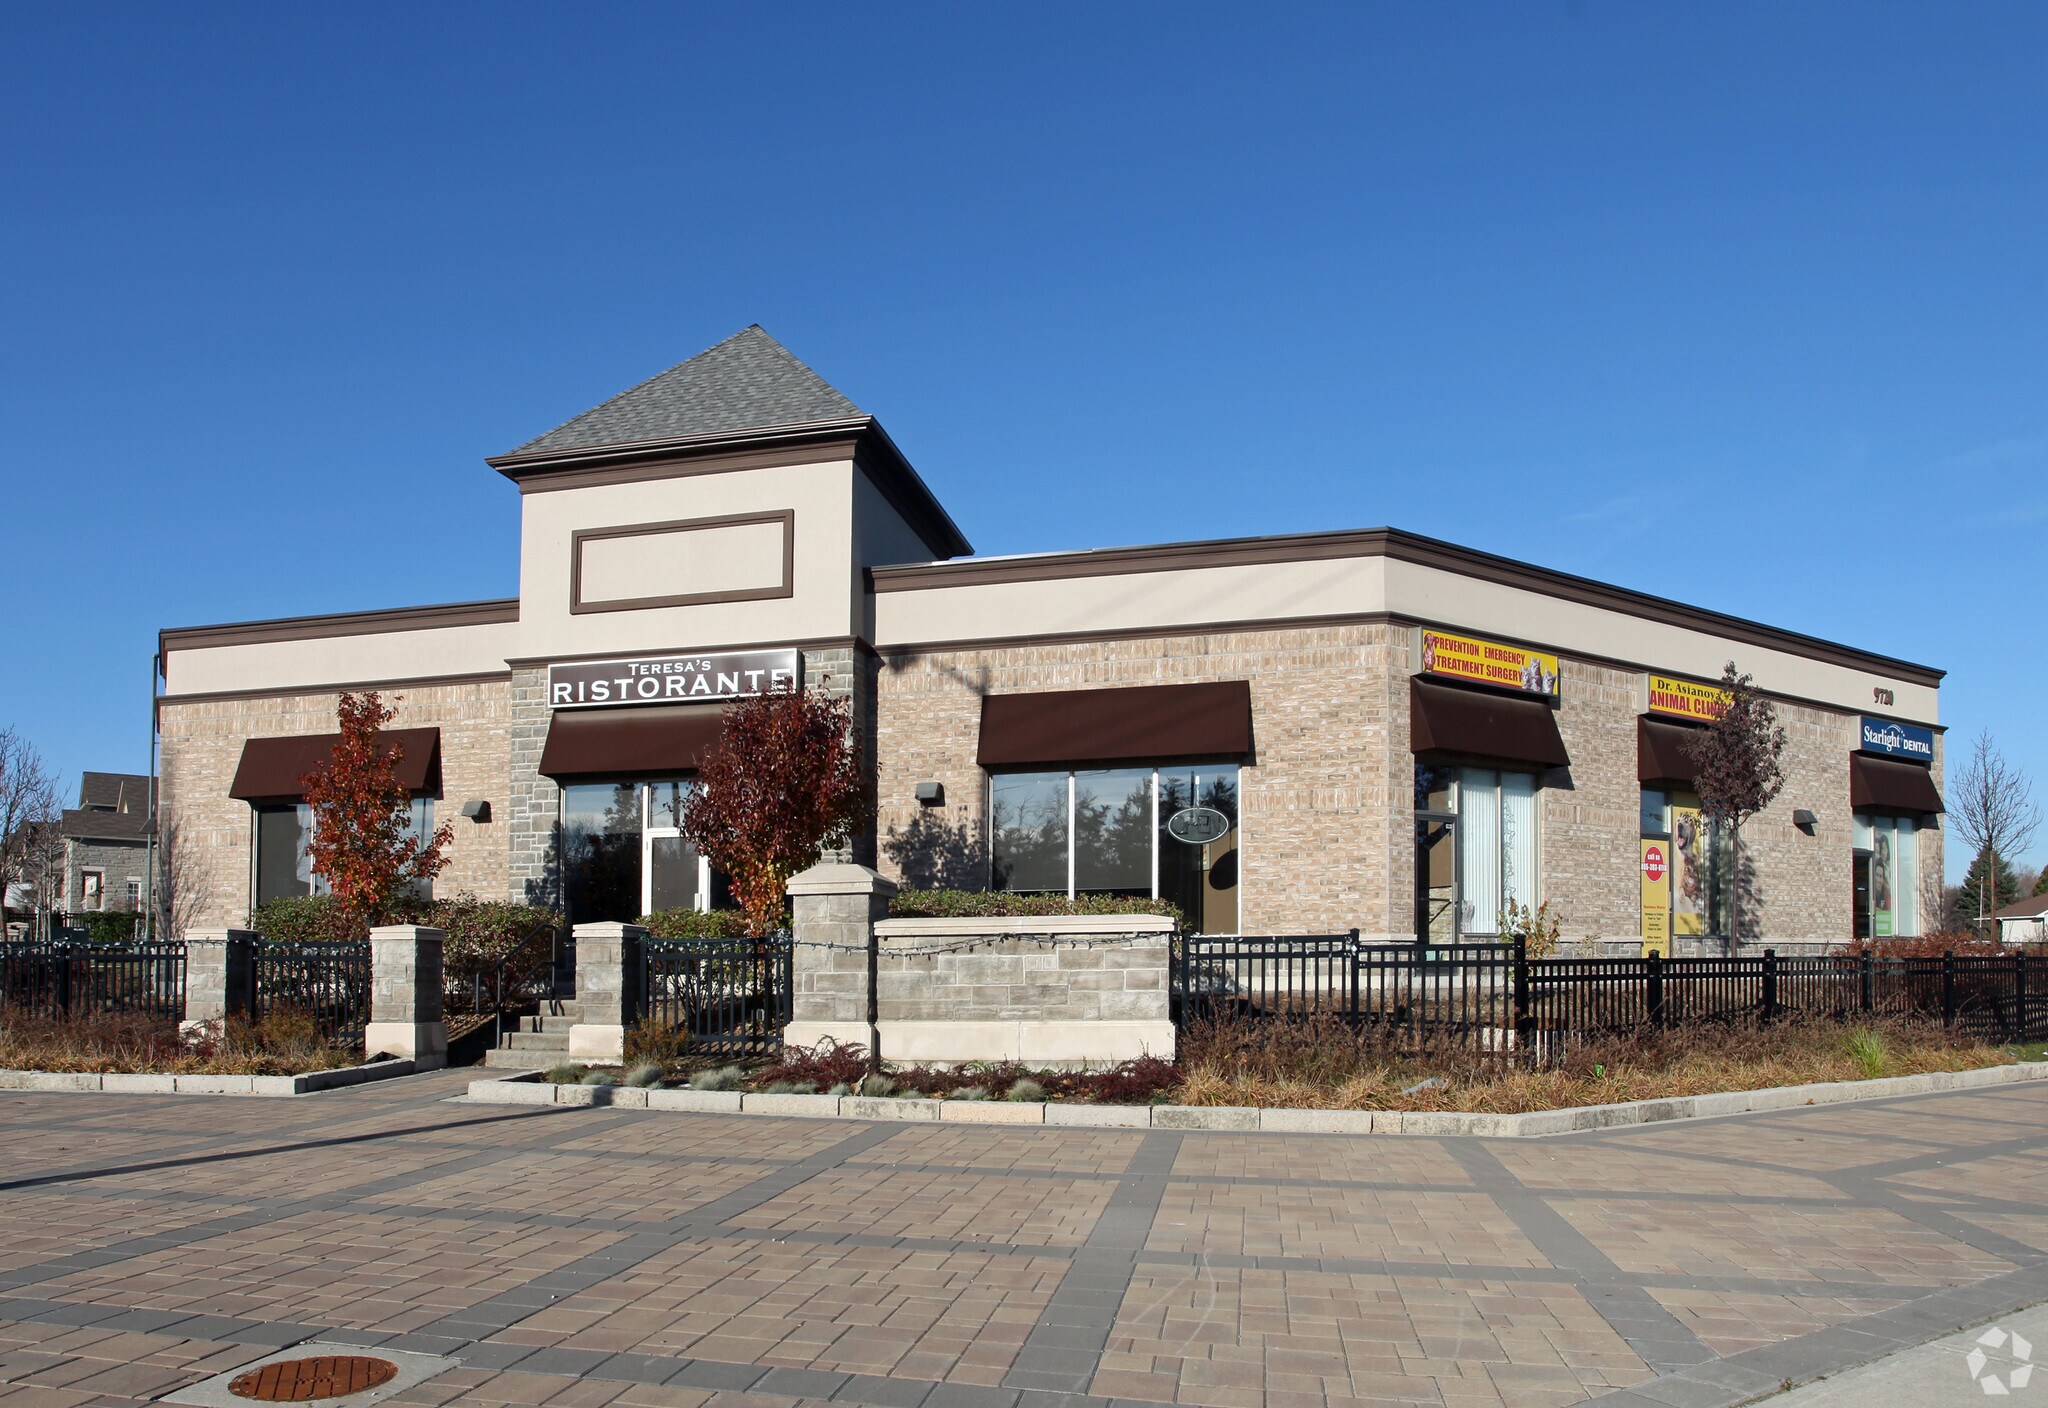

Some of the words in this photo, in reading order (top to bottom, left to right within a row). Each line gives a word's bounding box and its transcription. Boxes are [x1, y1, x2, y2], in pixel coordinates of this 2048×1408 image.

[1434, 635, 1480, 657] PREVENTION
[1484, 646, 1525, 666] EMERGENCY
[628, 659, 712, 676] TERESA'S
[1436, 655, 1484, 675] TREATMENT
[1486, 665, 1522, 683] SURGERY
[553, 668, 791, 704] RISTORANTE
[1657, 679, 1672, 691] Dr.
[1650, 690, 1691, 712] ANIMAL
[1864, 726, 1900, 752] Starlight
[1903, 739, 1931, 754] DENTAL
